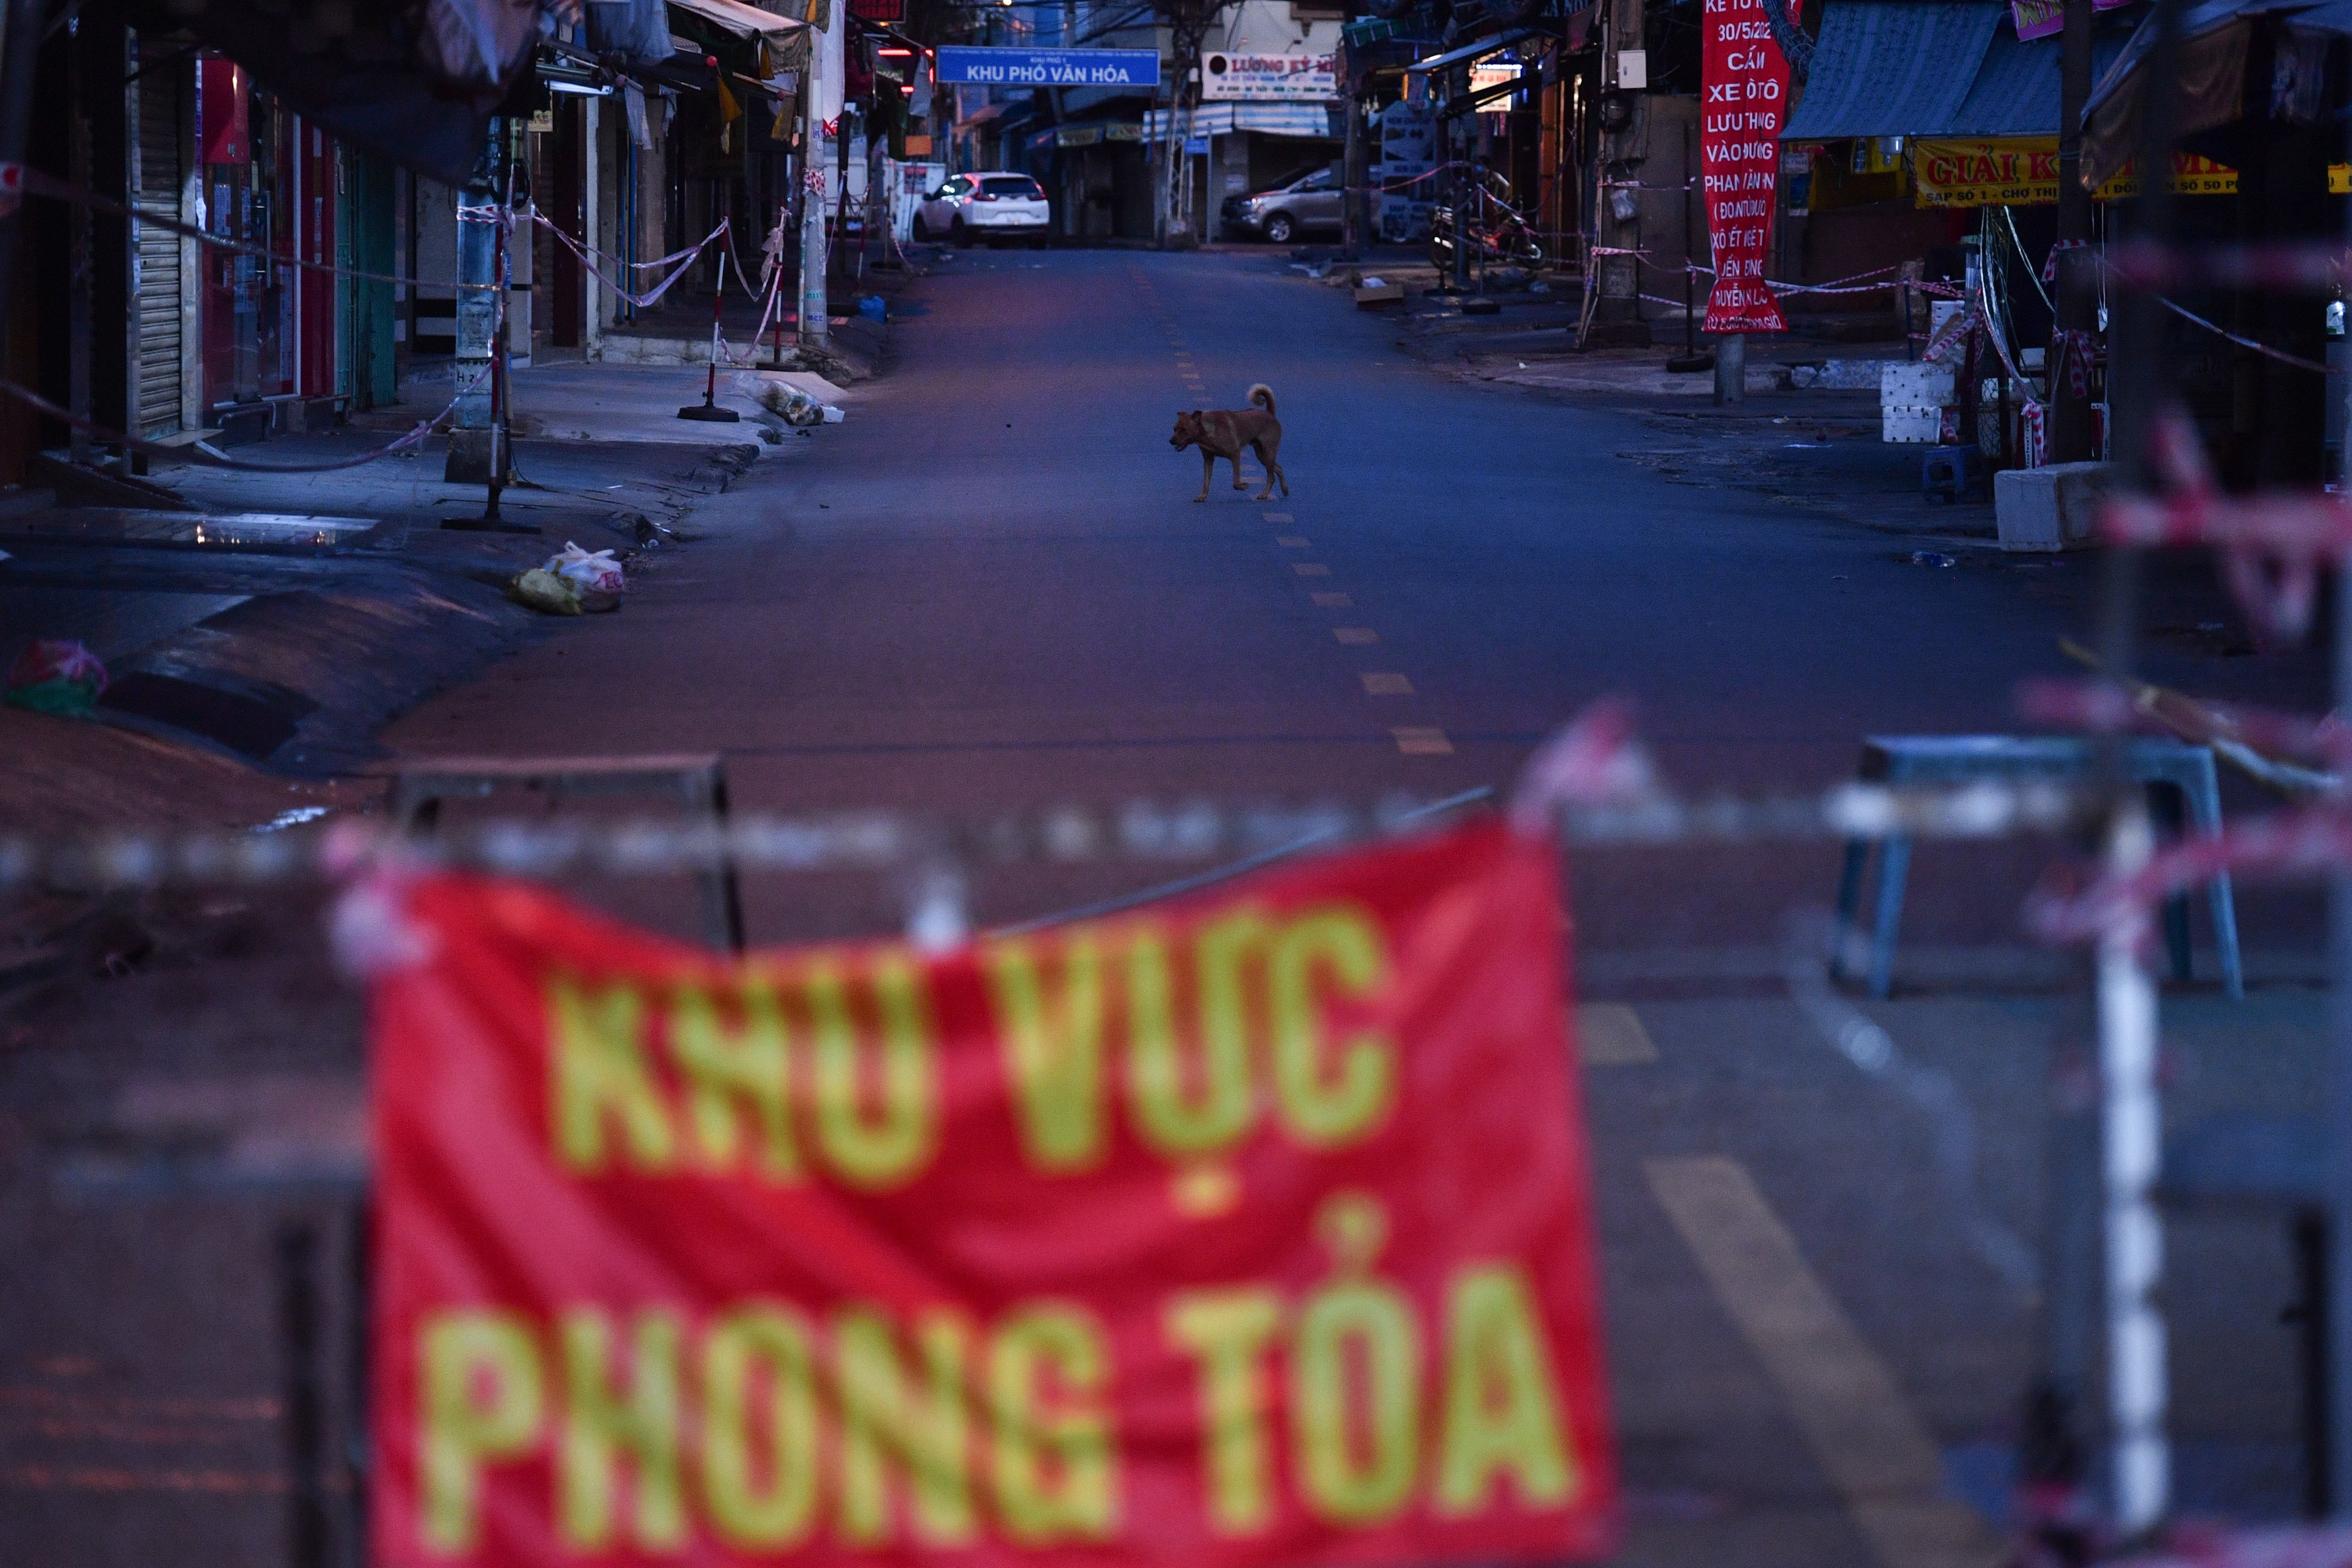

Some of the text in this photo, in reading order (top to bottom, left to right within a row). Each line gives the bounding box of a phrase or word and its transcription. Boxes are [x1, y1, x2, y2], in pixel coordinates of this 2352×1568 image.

[1718, 22, 1771, 41] 30/5/202
[967, 64, 1130, 83] KHU PHỐ VĂN HÓA
[1708, 83, 1741, 103] XE
[1708, 112, 1743, 133] LƯU
[1706, 140, 1741, 163] VÀO
[1927, 144, 2016, 185] GIẢI
[1705, 173, 1740, 192] PHAN
[1957, 188, 1975, 200] SỐ
[1981, 191, 1987, 199] 1
[2002, 188, 2030, 199] CHỢ
[2180, 178, 2197, 191] SỐ
[2204, 181, 2220, 190] 50
[1712, 227, 1727, 250] XÔ
[549, 905, 1396, 1215] KHU VỰC
[419, 1186, 1579, 1557] PHONG TỎA
